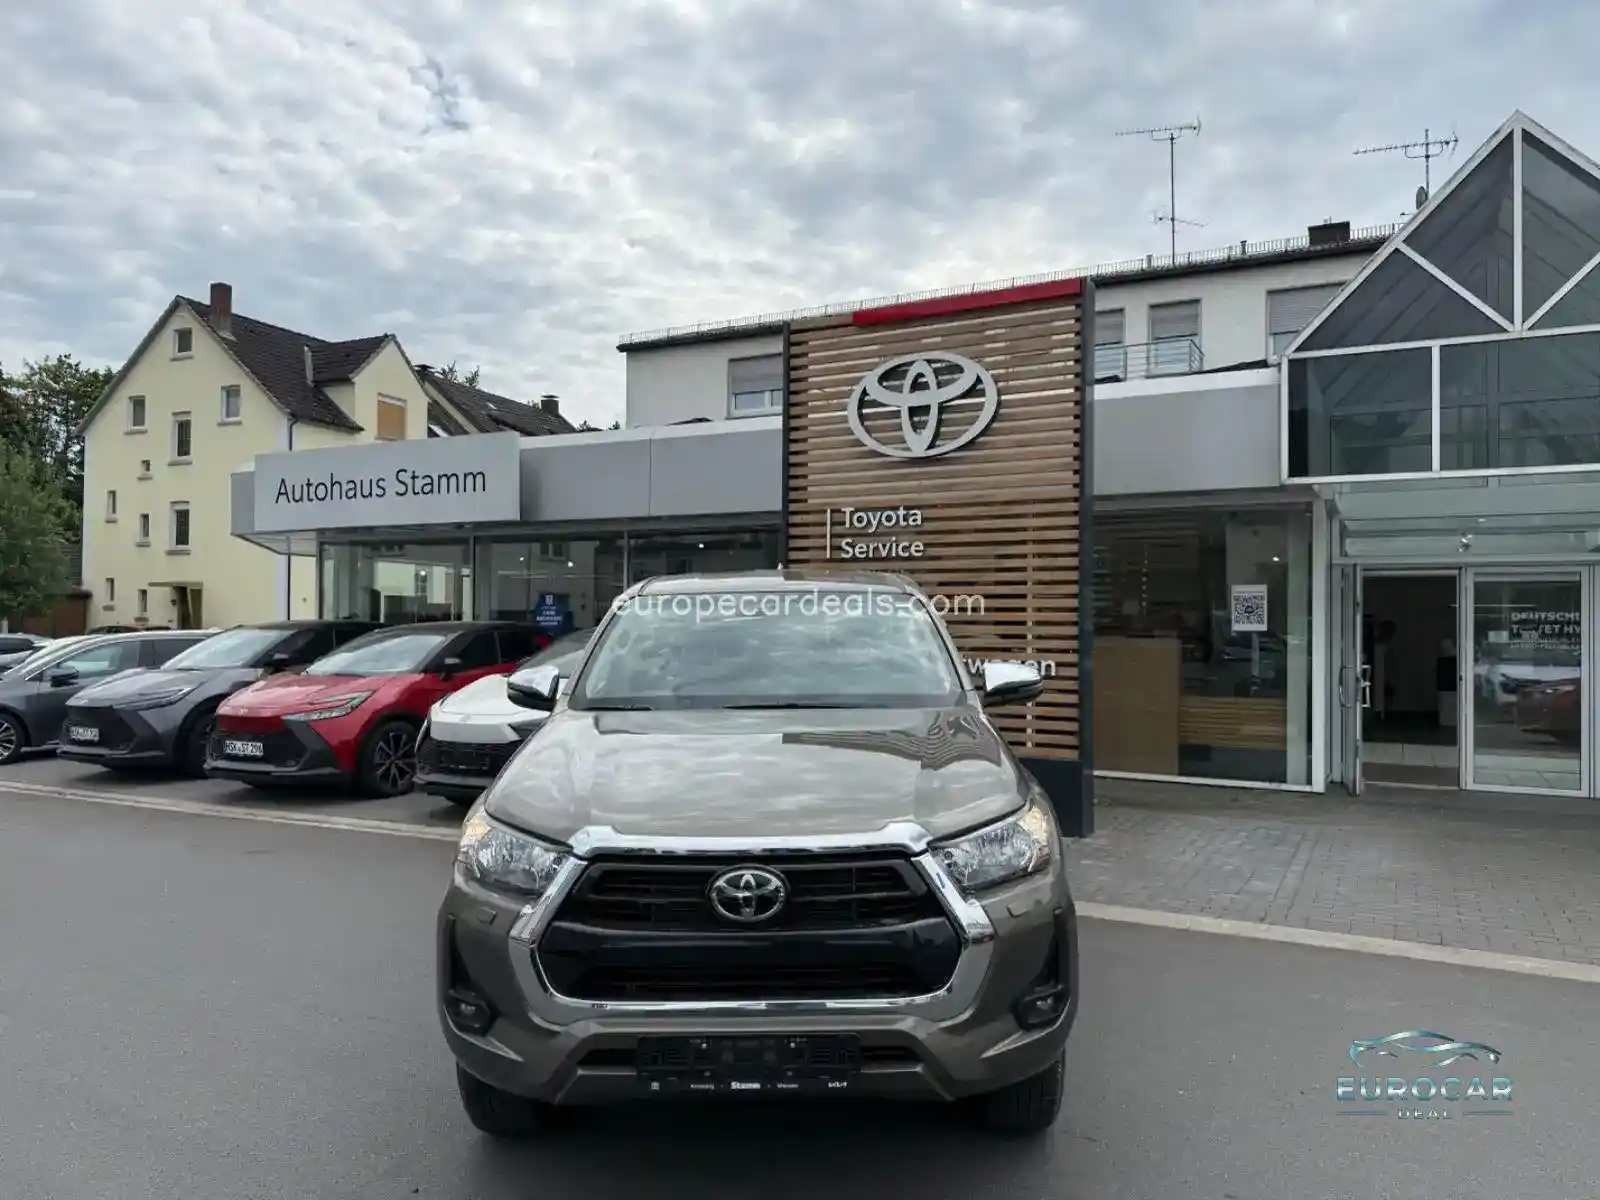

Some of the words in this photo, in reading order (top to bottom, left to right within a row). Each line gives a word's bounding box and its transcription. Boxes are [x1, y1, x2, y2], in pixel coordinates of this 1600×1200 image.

[275, 472, 387, 504] Autohaus
[394, 468, 487, 497] Stamm
[841, 504, 923, 533] Toyota
[841, 536, 925, 559] Service
